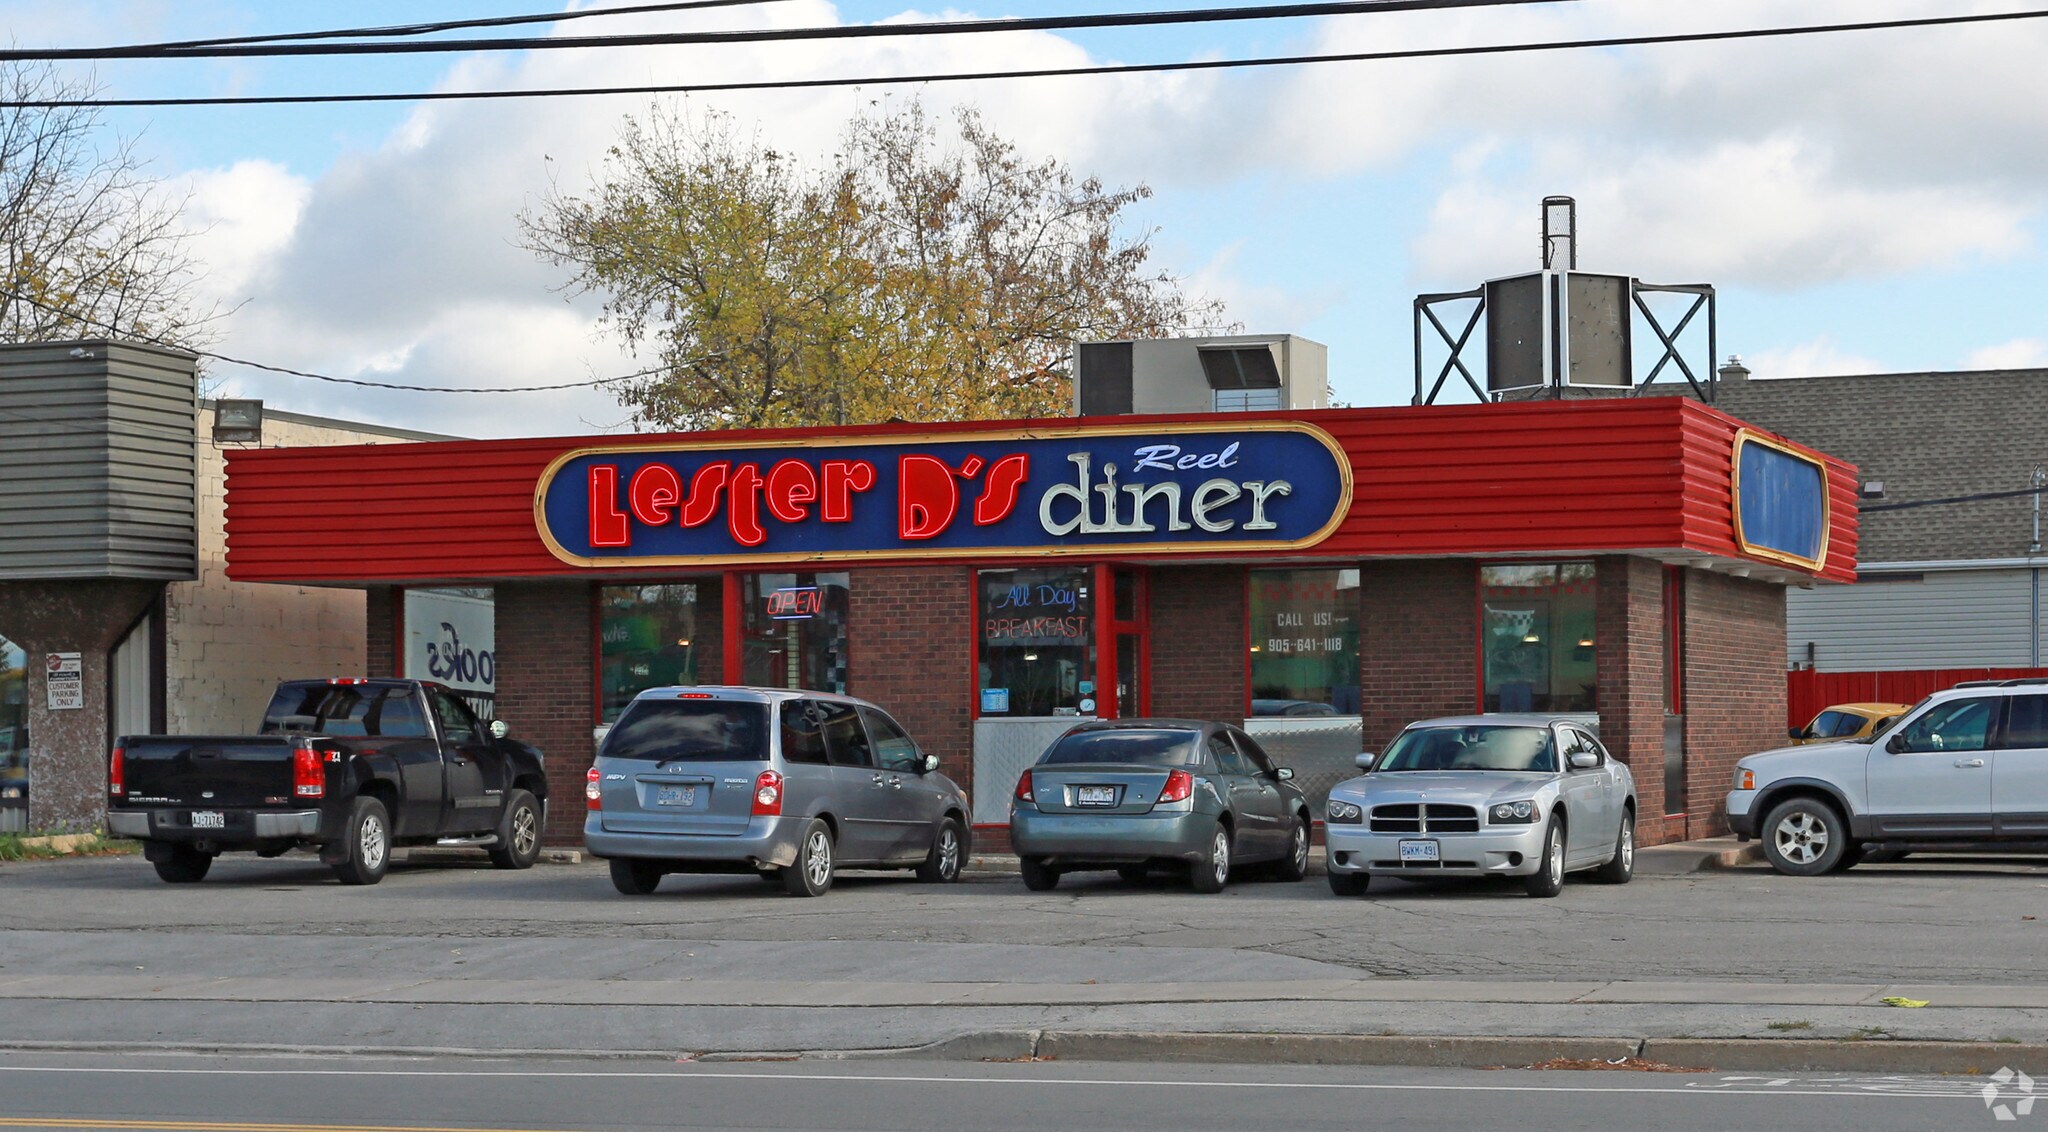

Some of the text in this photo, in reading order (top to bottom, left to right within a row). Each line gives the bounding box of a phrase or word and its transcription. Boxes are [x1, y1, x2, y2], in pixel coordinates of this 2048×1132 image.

[1133, 441, 1240, 472] Reel
[588, 451, 1292, 548] Lester D's diner
[767, 591, 822, 614] OPEN
[996, 584, 1076, 612] All Day
[986, 616, 1087, 639] BREAKFAST
[1277, 612, 1331, 626] CALL US!
[49, 682, 79, 690] CUSTOMER
[51, 690, 79, 698] PARKING
[56, 698, 74, 706] ONLY
